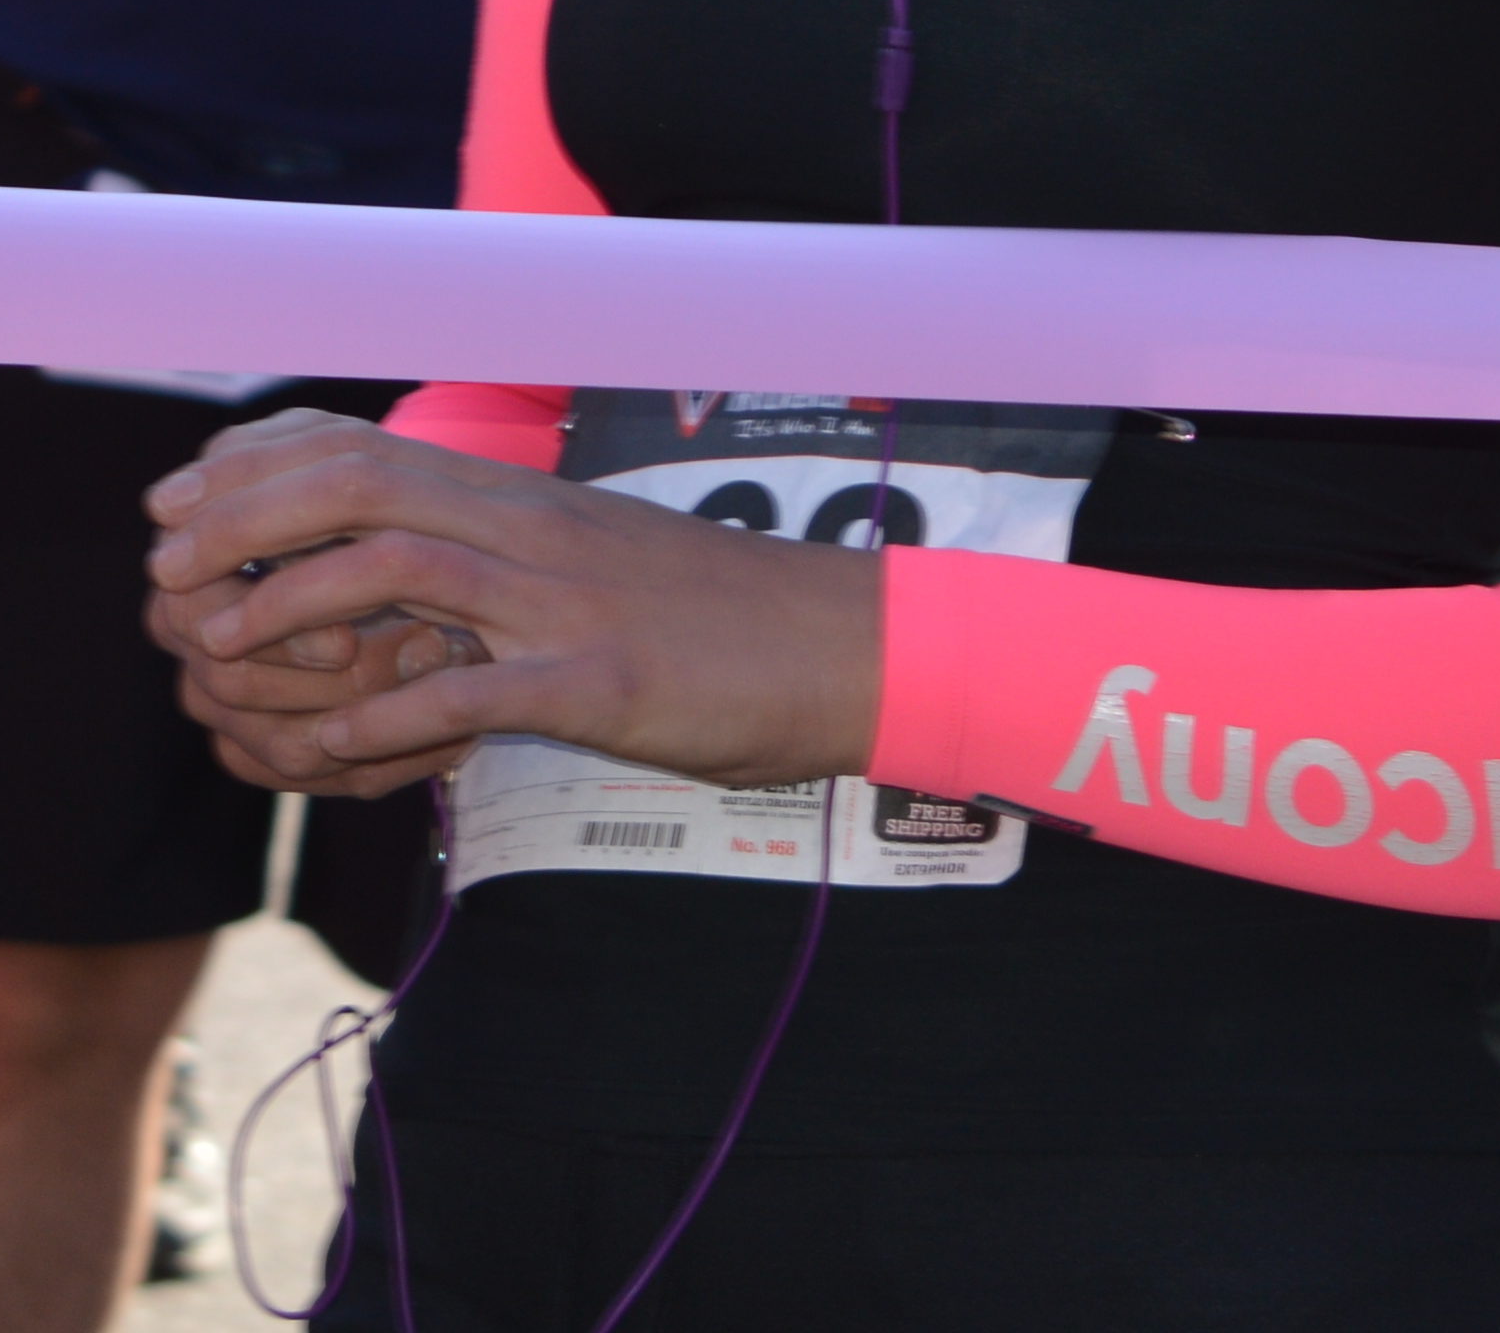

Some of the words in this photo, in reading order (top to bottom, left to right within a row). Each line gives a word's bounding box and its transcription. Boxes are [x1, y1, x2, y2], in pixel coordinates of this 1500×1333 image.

[908, 802, 966, 822] FREE
[884, 819, 985, 837] SHIPPING
[730, 836, 759, 854] No.
